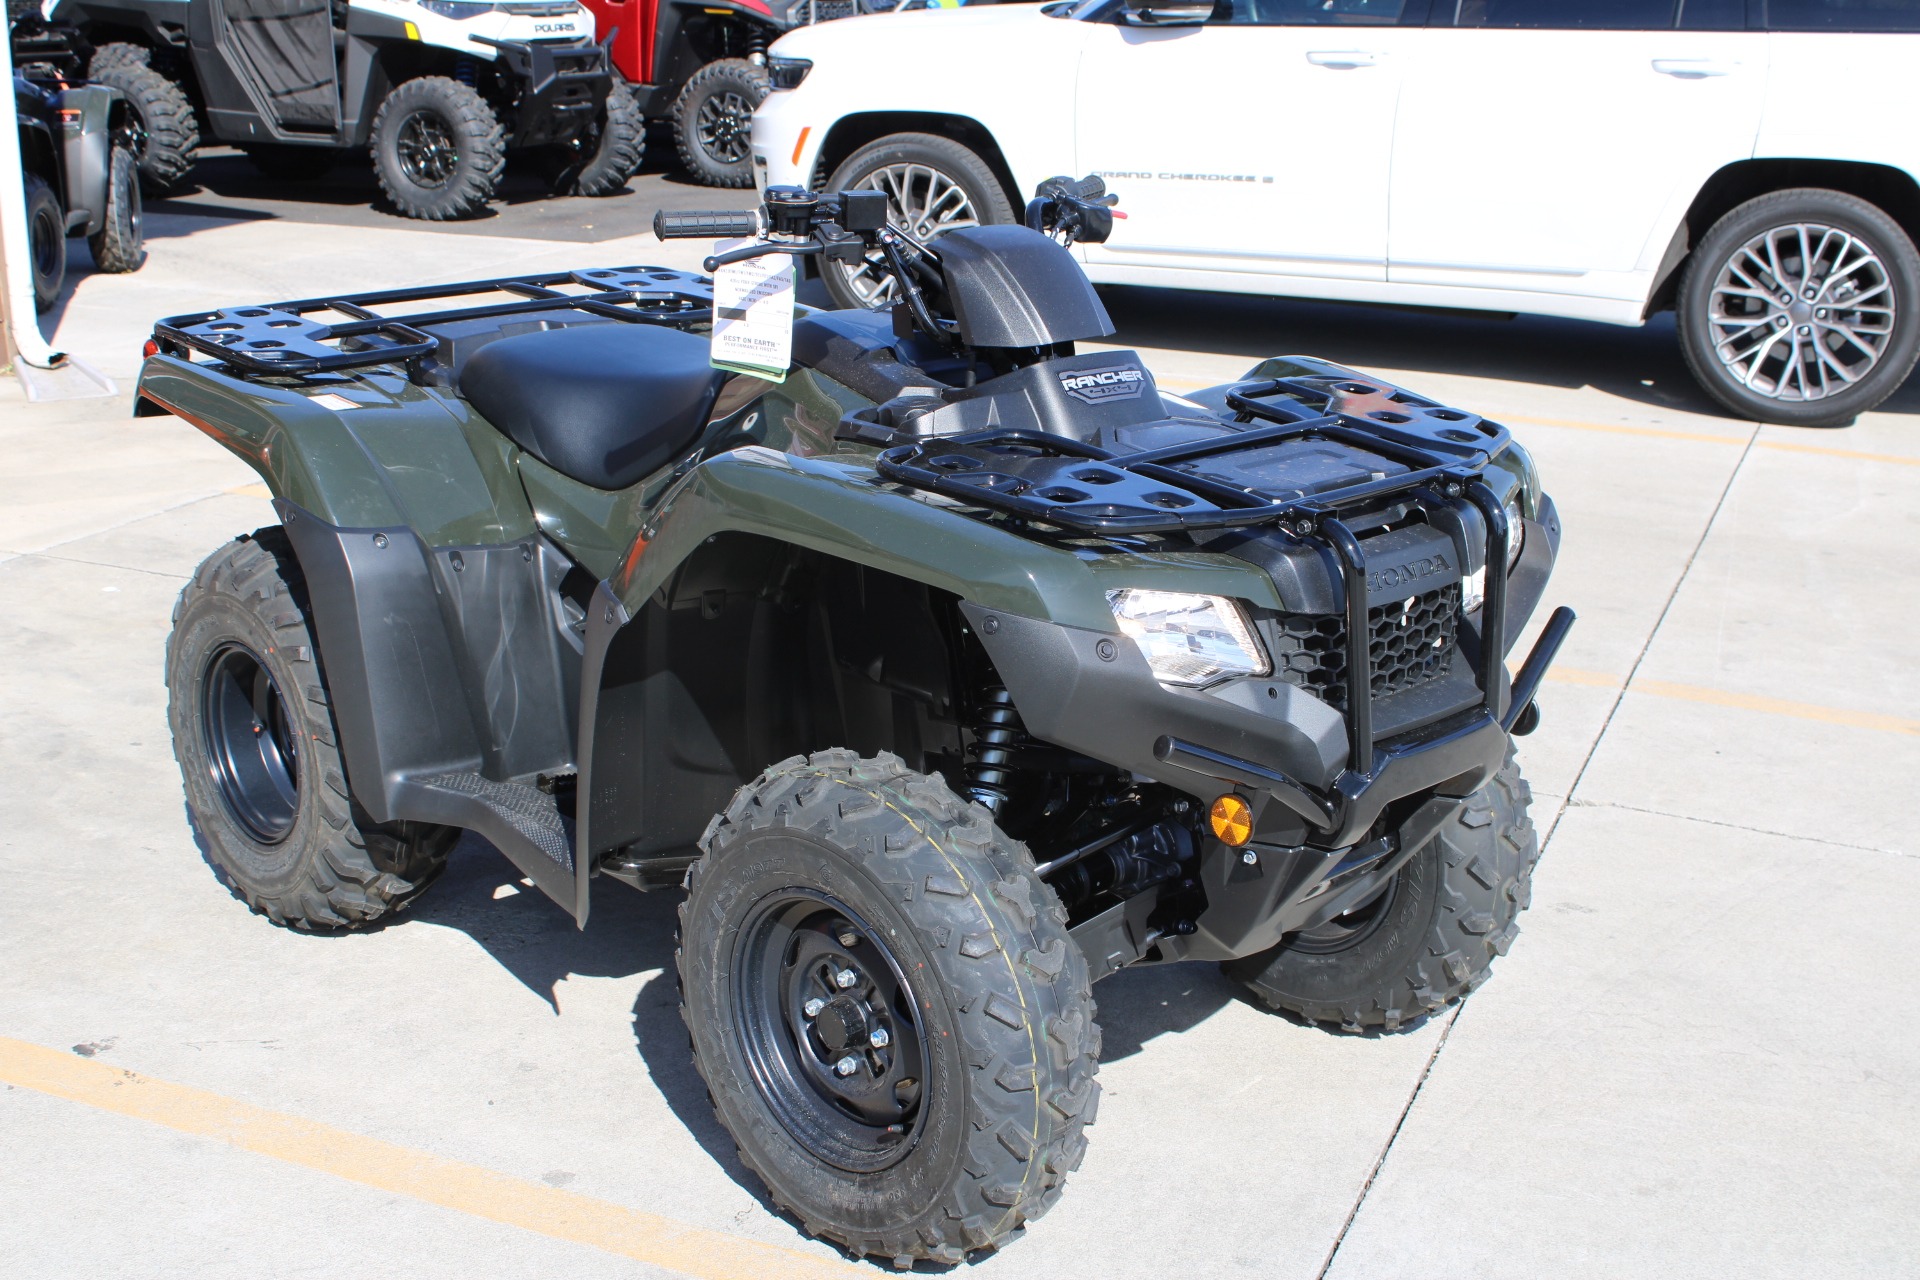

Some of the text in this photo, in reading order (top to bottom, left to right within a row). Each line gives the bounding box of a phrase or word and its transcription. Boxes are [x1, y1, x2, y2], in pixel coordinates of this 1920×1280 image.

[534, 23, 576, 33] POLARIS
[1090, 171, 1153, 180] GRAND
[1158, 172, 1257, 182] CHEROKEE
[723, 335, 741, 343] BEST
[724, 342, 758, 351] PERFORMANCE
[1061, 370, 1145, 391] RANCHER
[1366, 553, 1453, 593] HONDA
